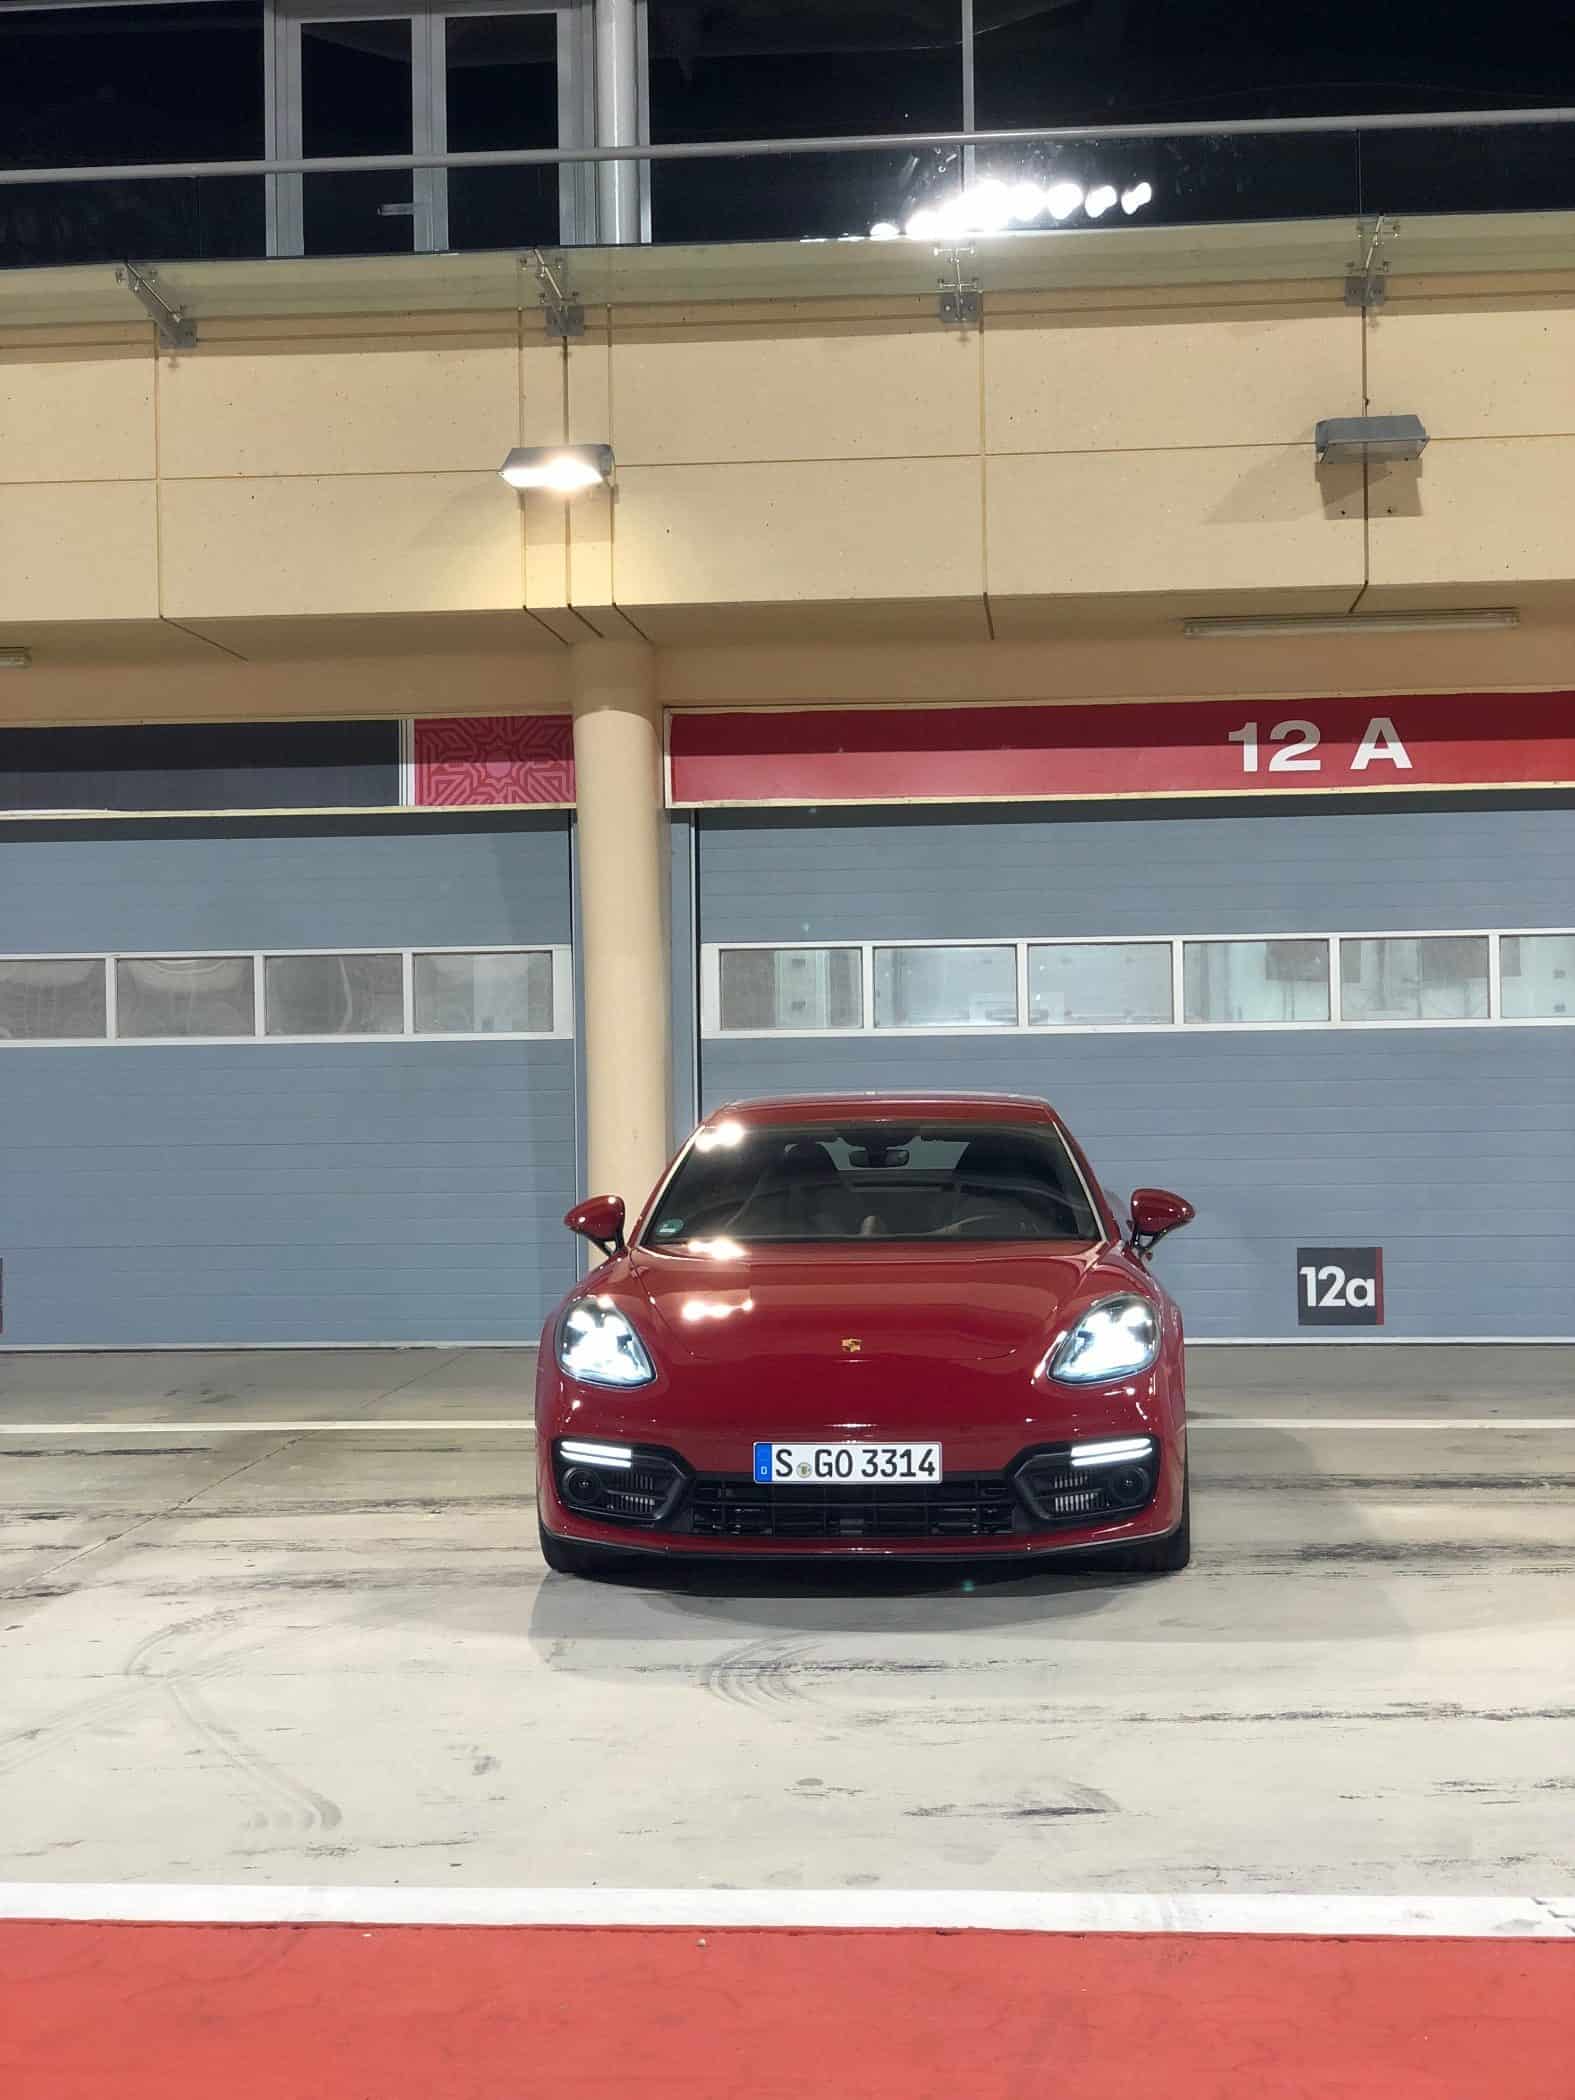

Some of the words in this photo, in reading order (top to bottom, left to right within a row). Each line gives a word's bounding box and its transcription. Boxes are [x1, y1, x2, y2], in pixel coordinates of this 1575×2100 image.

[1228, 719, 1321, 772] 12
[1350, 717, 1413, 770] A
[1299, 1265, 1376, 1308] 12a
[775, 1448, 793, 1478] S
[861, 1448, 936, 1478] 3314
